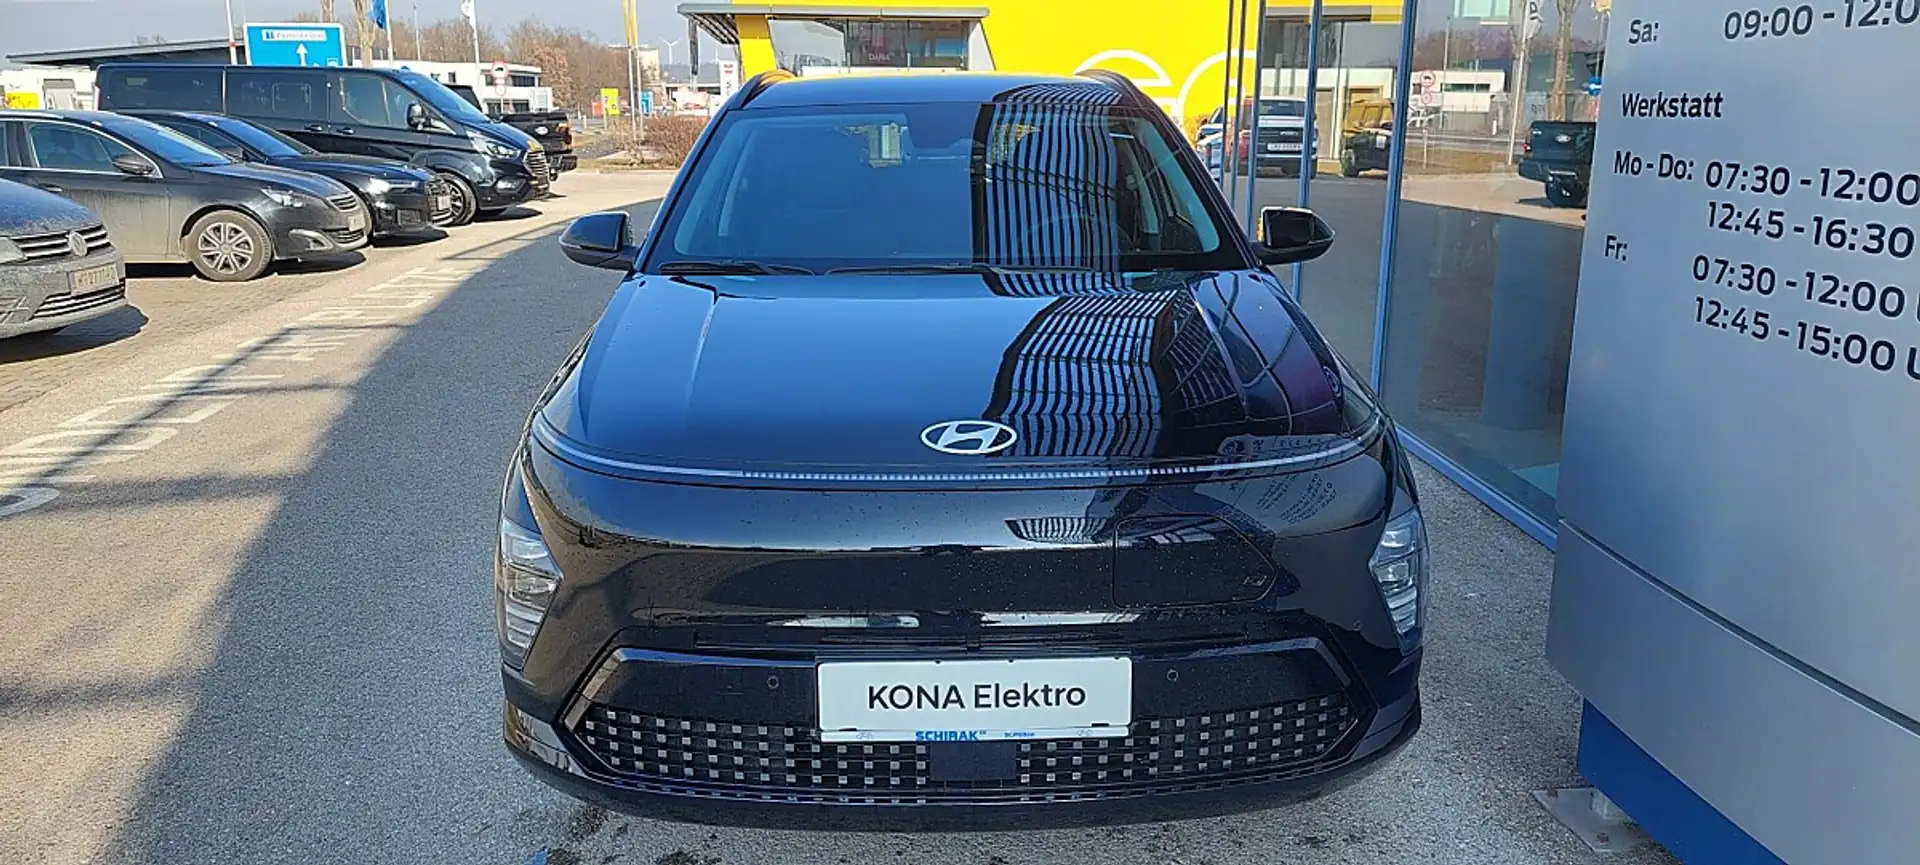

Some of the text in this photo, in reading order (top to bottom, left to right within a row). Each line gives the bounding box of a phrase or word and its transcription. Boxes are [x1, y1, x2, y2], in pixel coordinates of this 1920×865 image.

[1628, 19, 1659, 45] Sa:
[1724, 5, 1813, 39] 09:00
[1622, 91, 1724, 118] Werkstatt
[1614, 151, 1642, 176] Mo
[1658, 153, 1694, 181] Do:
[1706, 161, 1791, 196] 07:30
[1819, 168, 1920, 206] 12:00
[1605, 235, 1628, 261] Fr:
[1708, 201, 1785, 239] 12:45
[1812, 216, 1915, 258] 16:30
[1693, 255, 1776, 295] 07:30
[1805, 272, 1905, 318] 12:00
[1696, 297, 1769, 340] 12:45
[1797, 322, 1896, 372] 15:00
[868, 683, 1086, 710] KONA Elektro
[915, 730, 978, 742] SCHIRAK
